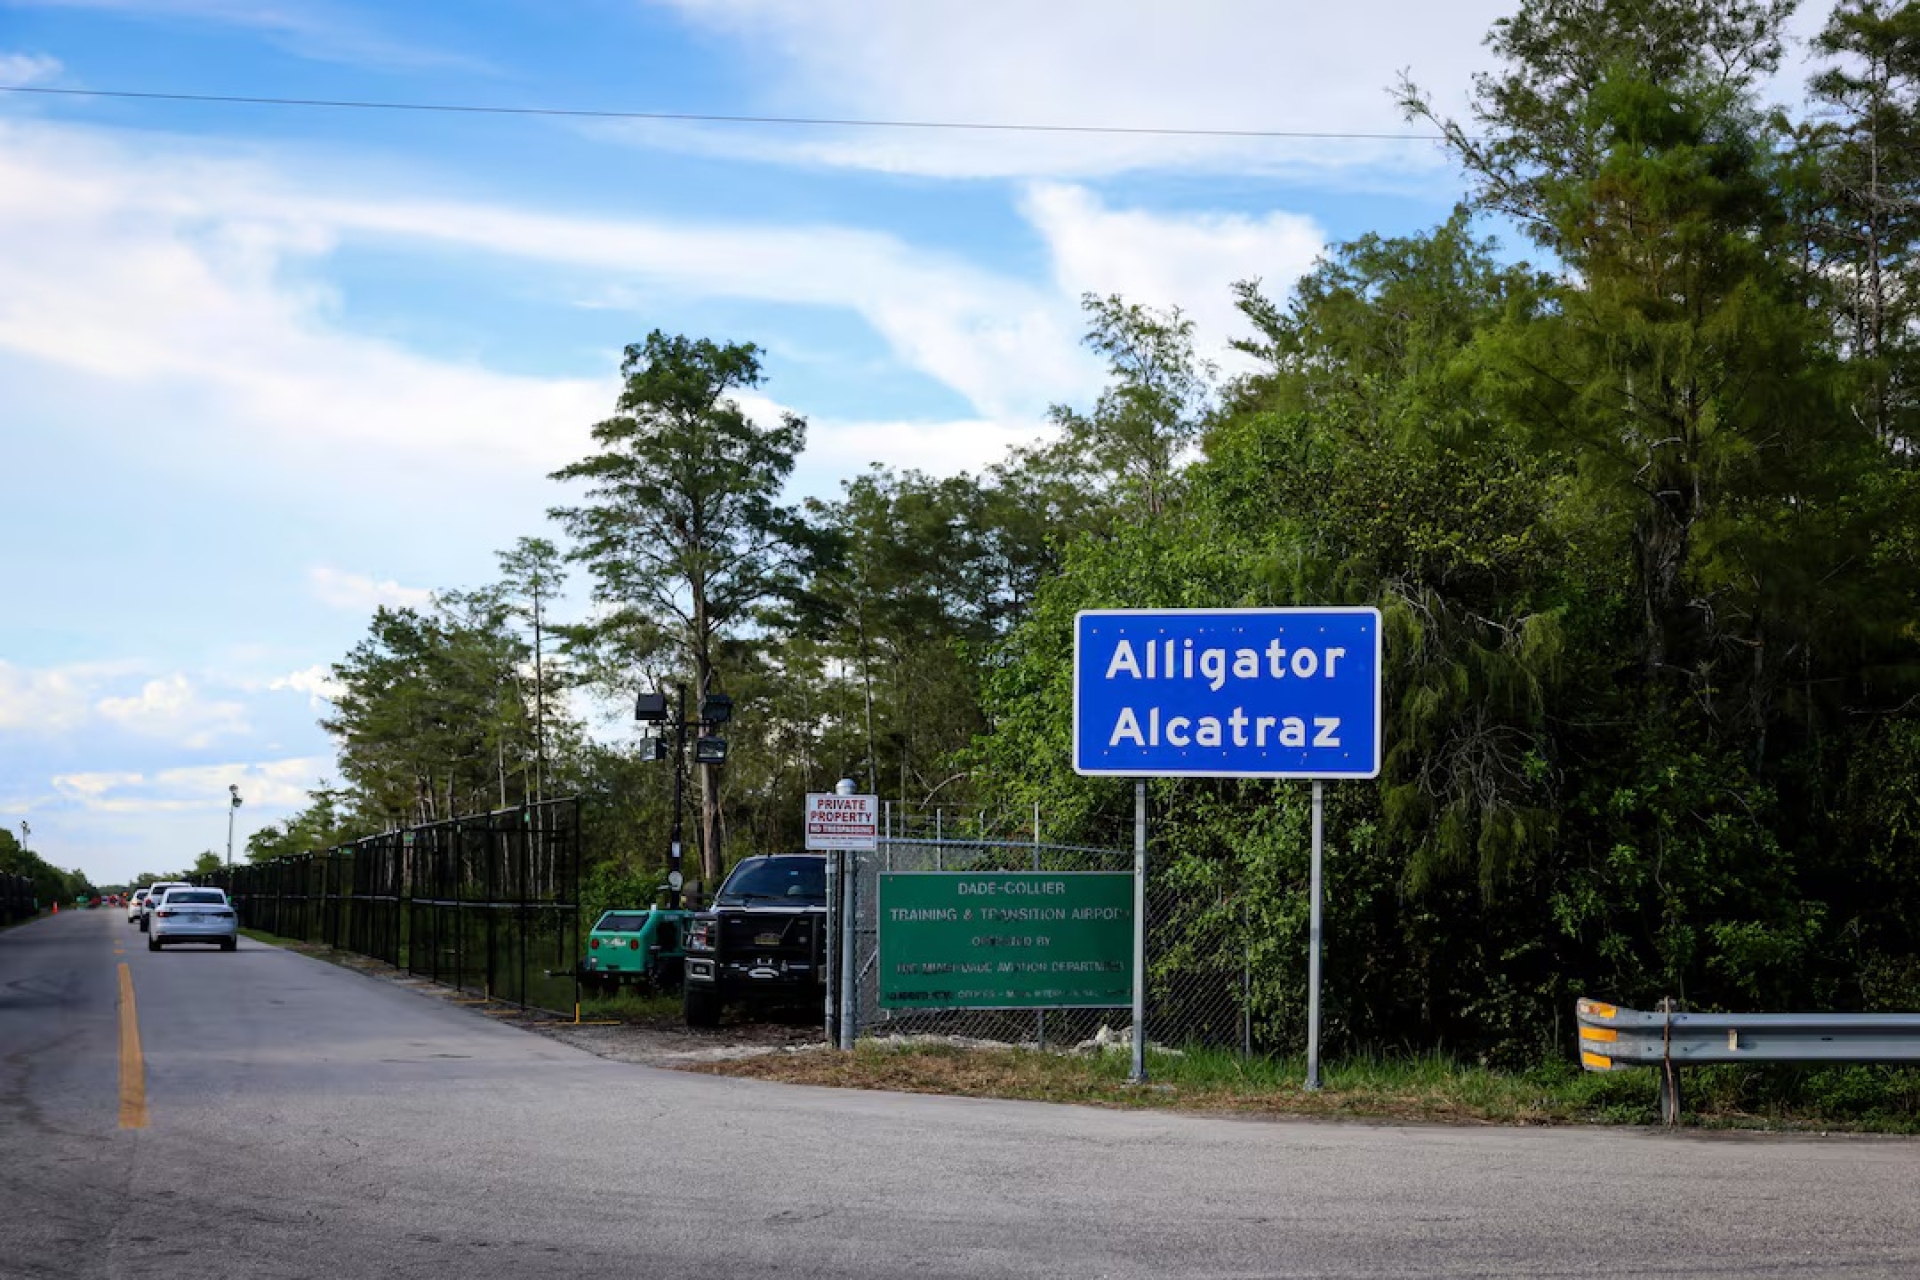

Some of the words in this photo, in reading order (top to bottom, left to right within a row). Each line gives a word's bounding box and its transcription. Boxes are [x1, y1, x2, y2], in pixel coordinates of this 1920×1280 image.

[1105, 638, 1346, 692] Alligator
[1109, 706, 1341, 748] Alcatraz
[817, 799, 866, 810] PRIVATE
[810, 811, 872, 822] PROPERTY
[957, 881, 1066, 895] DADE-COLLIER
[889, 908, 957, 921] TRAINING
[963, 908, 973, 921] &
